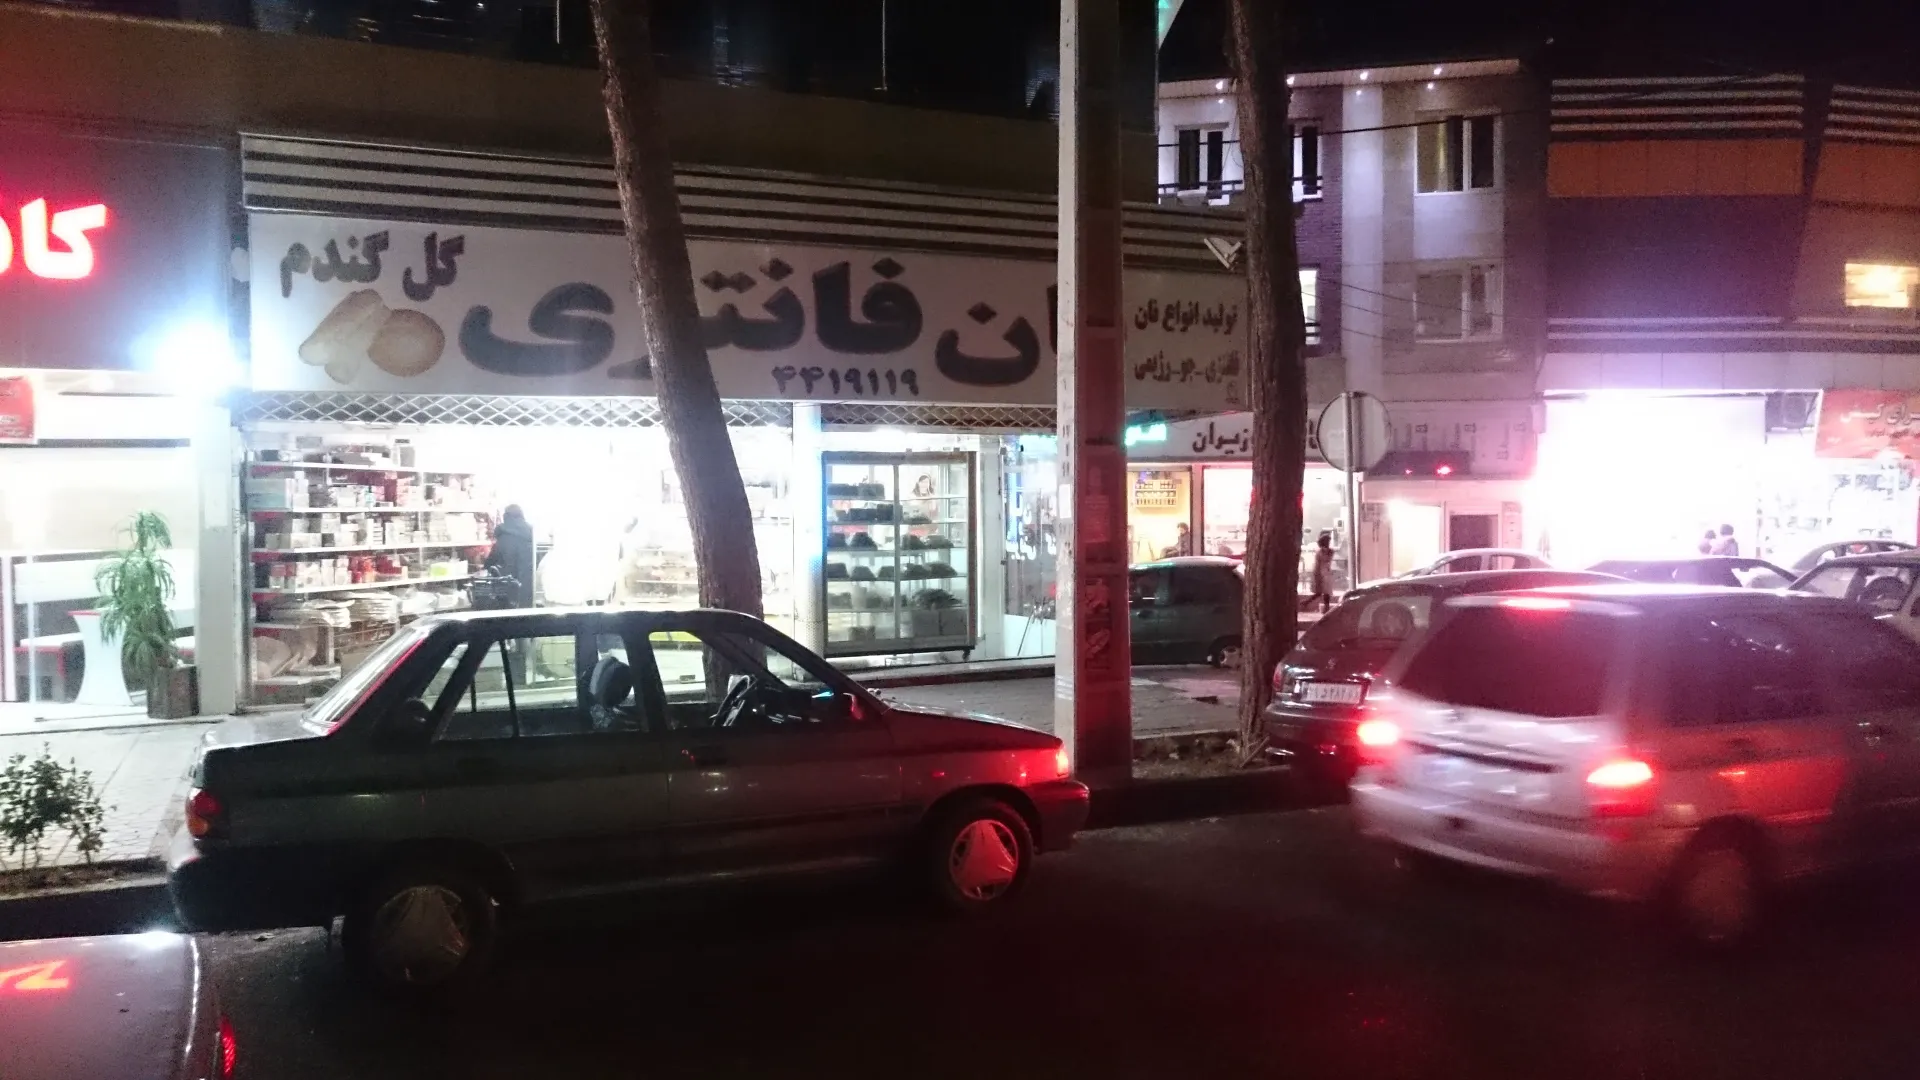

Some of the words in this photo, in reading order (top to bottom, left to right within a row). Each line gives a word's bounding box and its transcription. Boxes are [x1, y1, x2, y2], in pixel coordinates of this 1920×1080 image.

[279, 230, 389, 299] گندم
[402, 230, 465, 302] گل
[1134, 298, 1159, 330] نان
[1162, 299, 1199, 332] انواع
[1202, 303, 1238, 335] تولید
[771, 365, 919, 397] ۴۴۱۹۱۱۹
